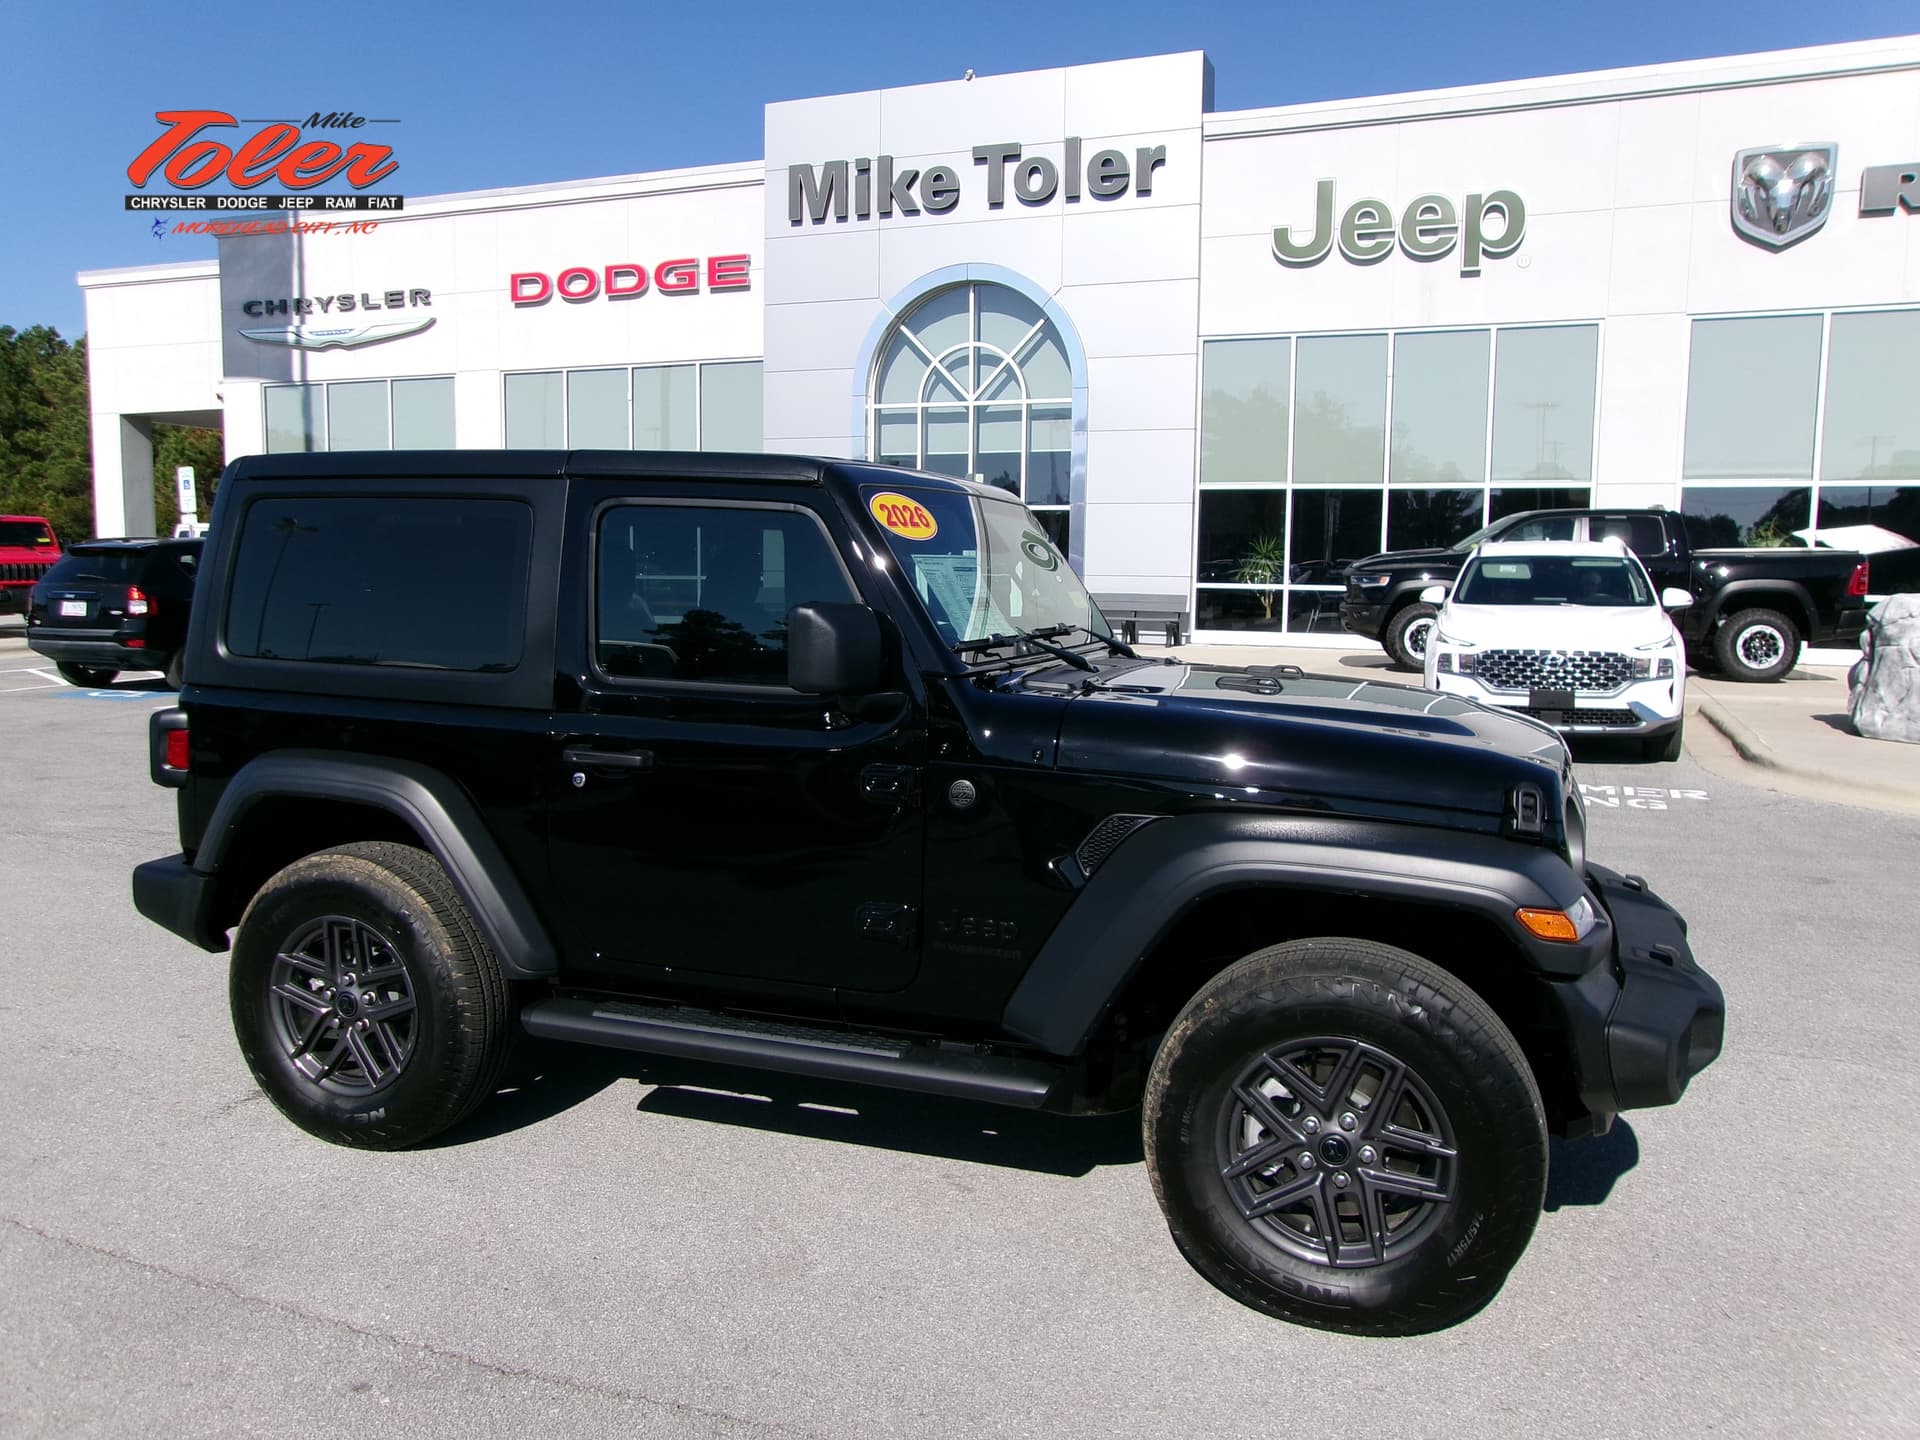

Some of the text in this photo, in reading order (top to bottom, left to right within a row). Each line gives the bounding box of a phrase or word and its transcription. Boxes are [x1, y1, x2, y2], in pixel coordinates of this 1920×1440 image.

[788, 137, 1167, 227] Mike Toler
[1272, 176, 1527, 278] Jeep
[243, 288, 433, 318] CHRYSLER
[510, 252, 751, 308] DODGE
[878, 502, 932, 530] 2026
